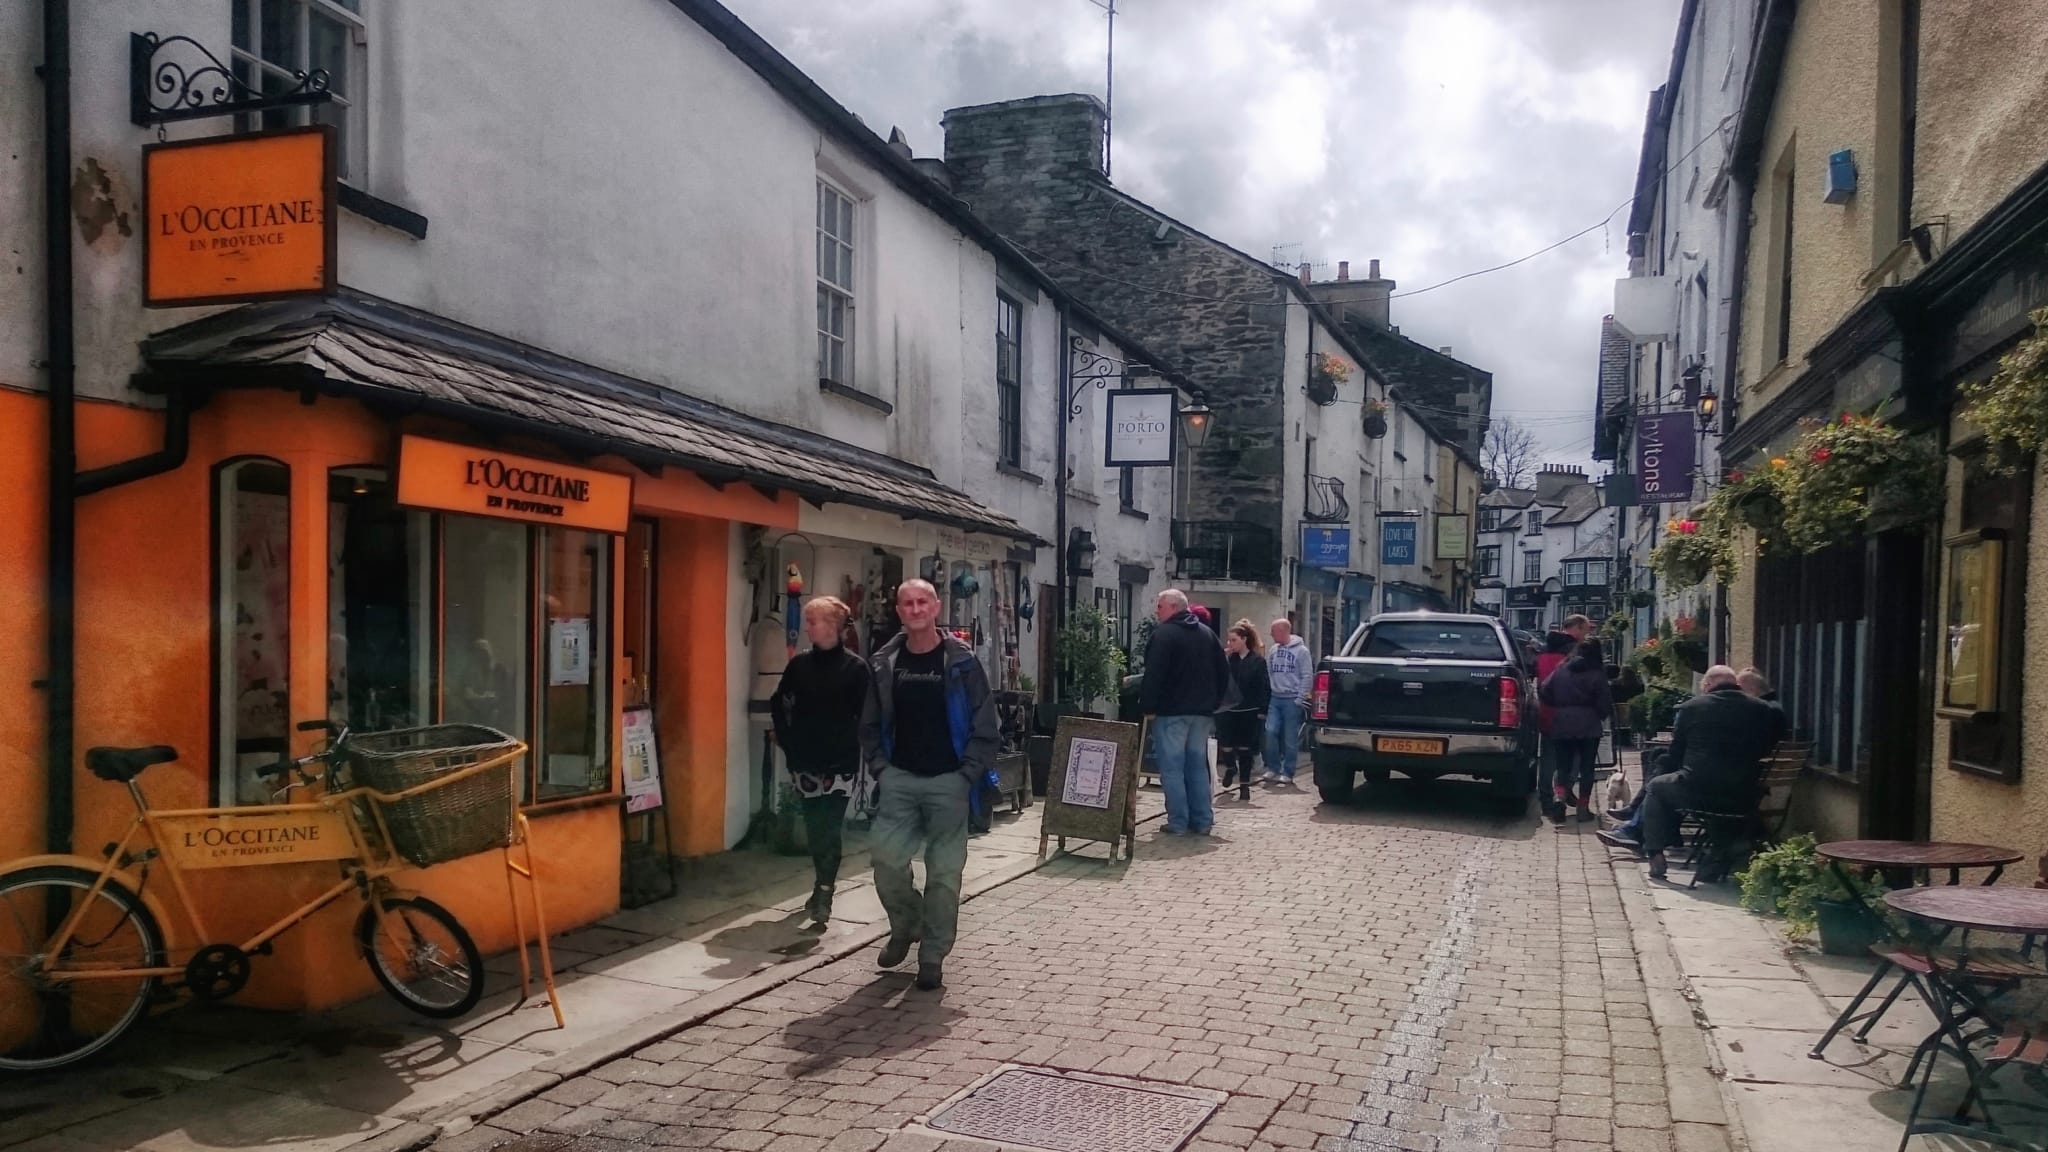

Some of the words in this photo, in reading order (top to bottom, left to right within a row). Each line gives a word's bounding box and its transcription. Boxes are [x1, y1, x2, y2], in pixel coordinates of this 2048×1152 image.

[189, 239, 207, 251] EN
[212, 232, 285, 250] PROVENCE
[1117, 422, 1165, 434] PORTO
[1640, 419, 1664, 493] hyltons
[486, 495, 503, 507] EN
[506, 497, 565, 517] PROVENCE
[1385, 527, 1402, 542] LOVE
[1402, 528, 1414, 542] THE
[1387, 545, 1409, 559] LAKES
[1382, 739, 1412, 751] PX65
[1415, 741, 1438, 752] XZN
[212, 848, 227, 858] EN
[232, 844, 295, 857] PROVENCE
